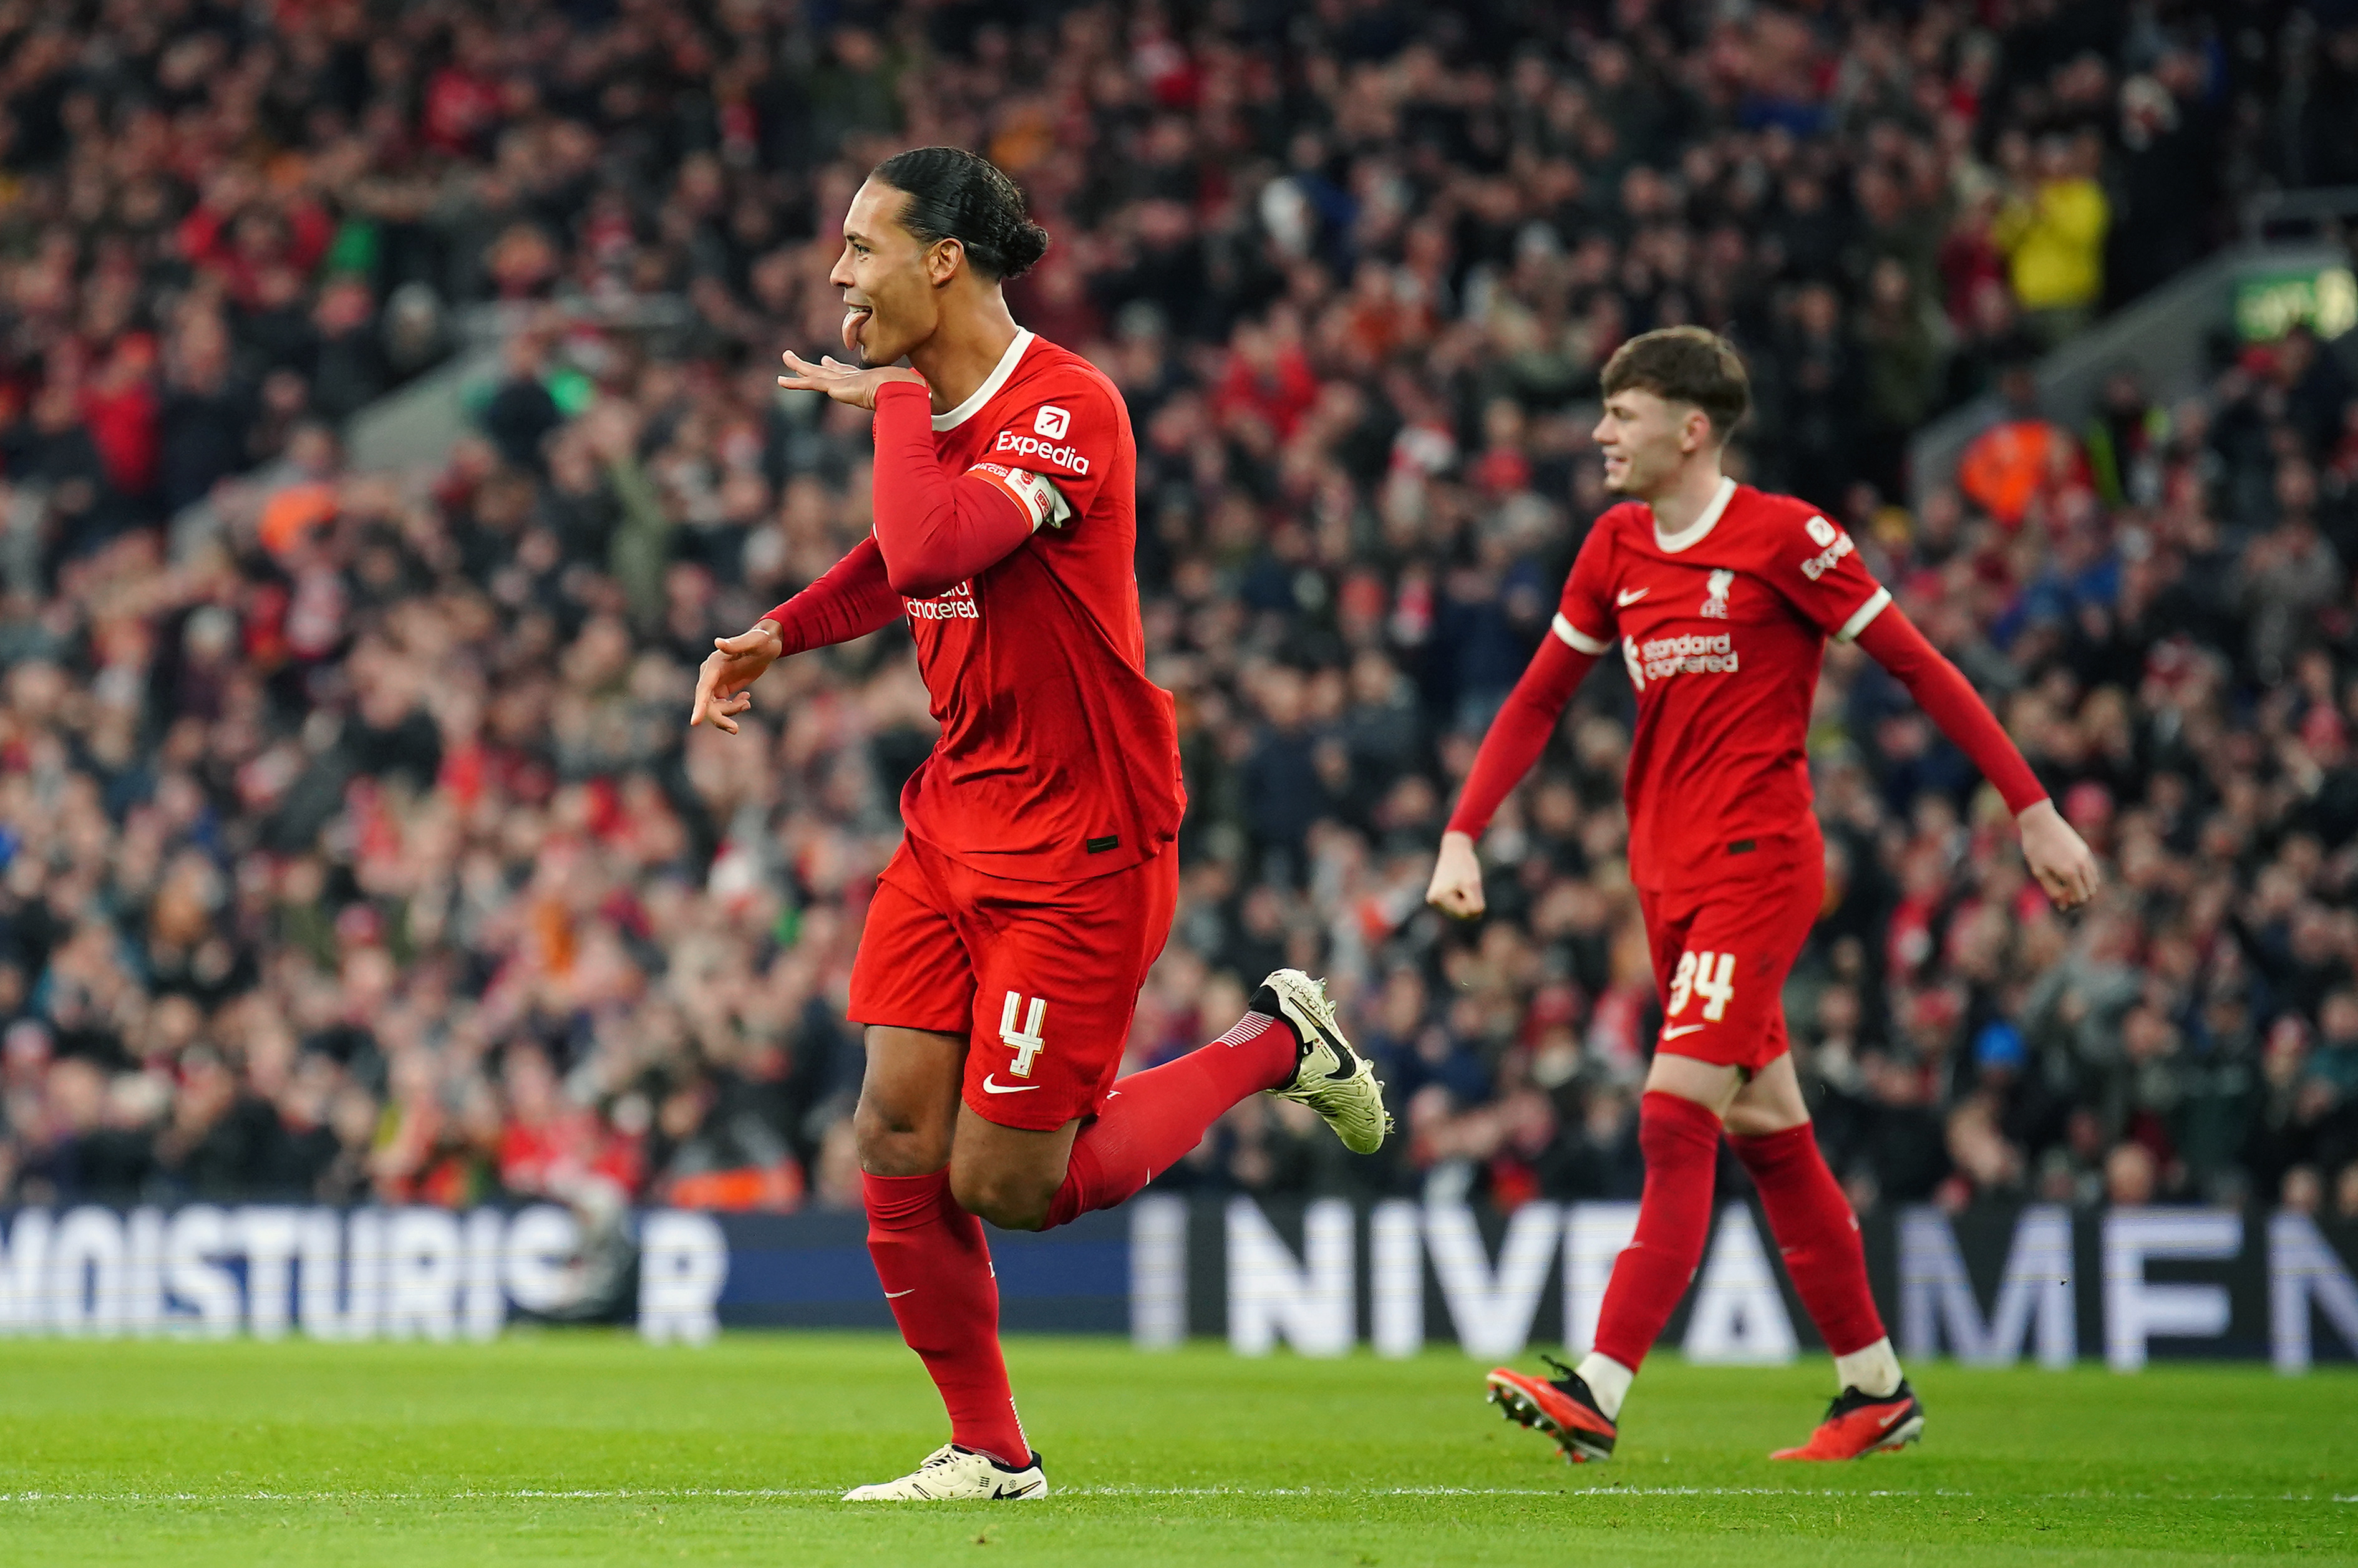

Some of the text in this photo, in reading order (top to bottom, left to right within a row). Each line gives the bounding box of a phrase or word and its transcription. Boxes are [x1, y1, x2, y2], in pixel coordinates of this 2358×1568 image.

[987, 467, 1007, 477] CUP
[996, 430, 1090, 475] Expedia
[1667, 950, 1736, 1023] 34
[999, 990, 1047, 1079] 4
